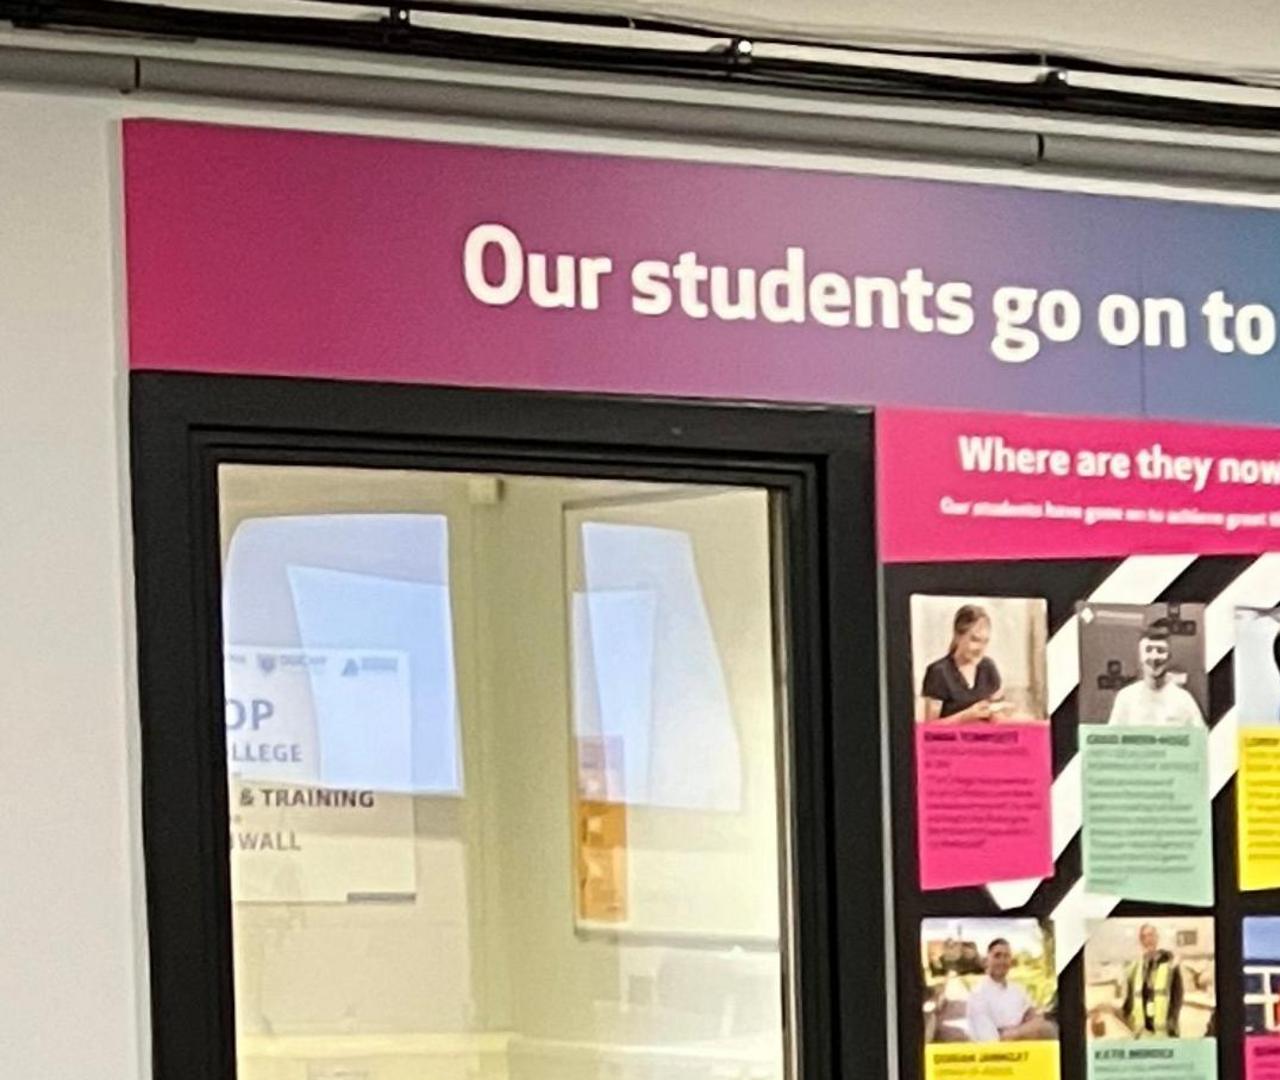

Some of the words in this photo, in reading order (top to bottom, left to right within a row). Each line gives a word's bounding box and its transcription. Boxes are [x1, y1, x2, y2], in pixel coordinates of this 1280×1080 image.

[463, 223, 612, 310] Our
[631, 246, 975, 336] students
[989, 285, 1082, 363] go
[1097, 293, 1187, 349] on
[1201, 290, 1276, 356] to
[958, 435, 1071, 476] Where
[1076, 450, 1131, 479] are
[1136, 443, 1212, 492] they
[225, 698, 275, 732] OP
[232, 742, 303, 764] LLEGE
[261, 788, 375, 807] TRAINING
[238, 832, 301, 852] WALL
